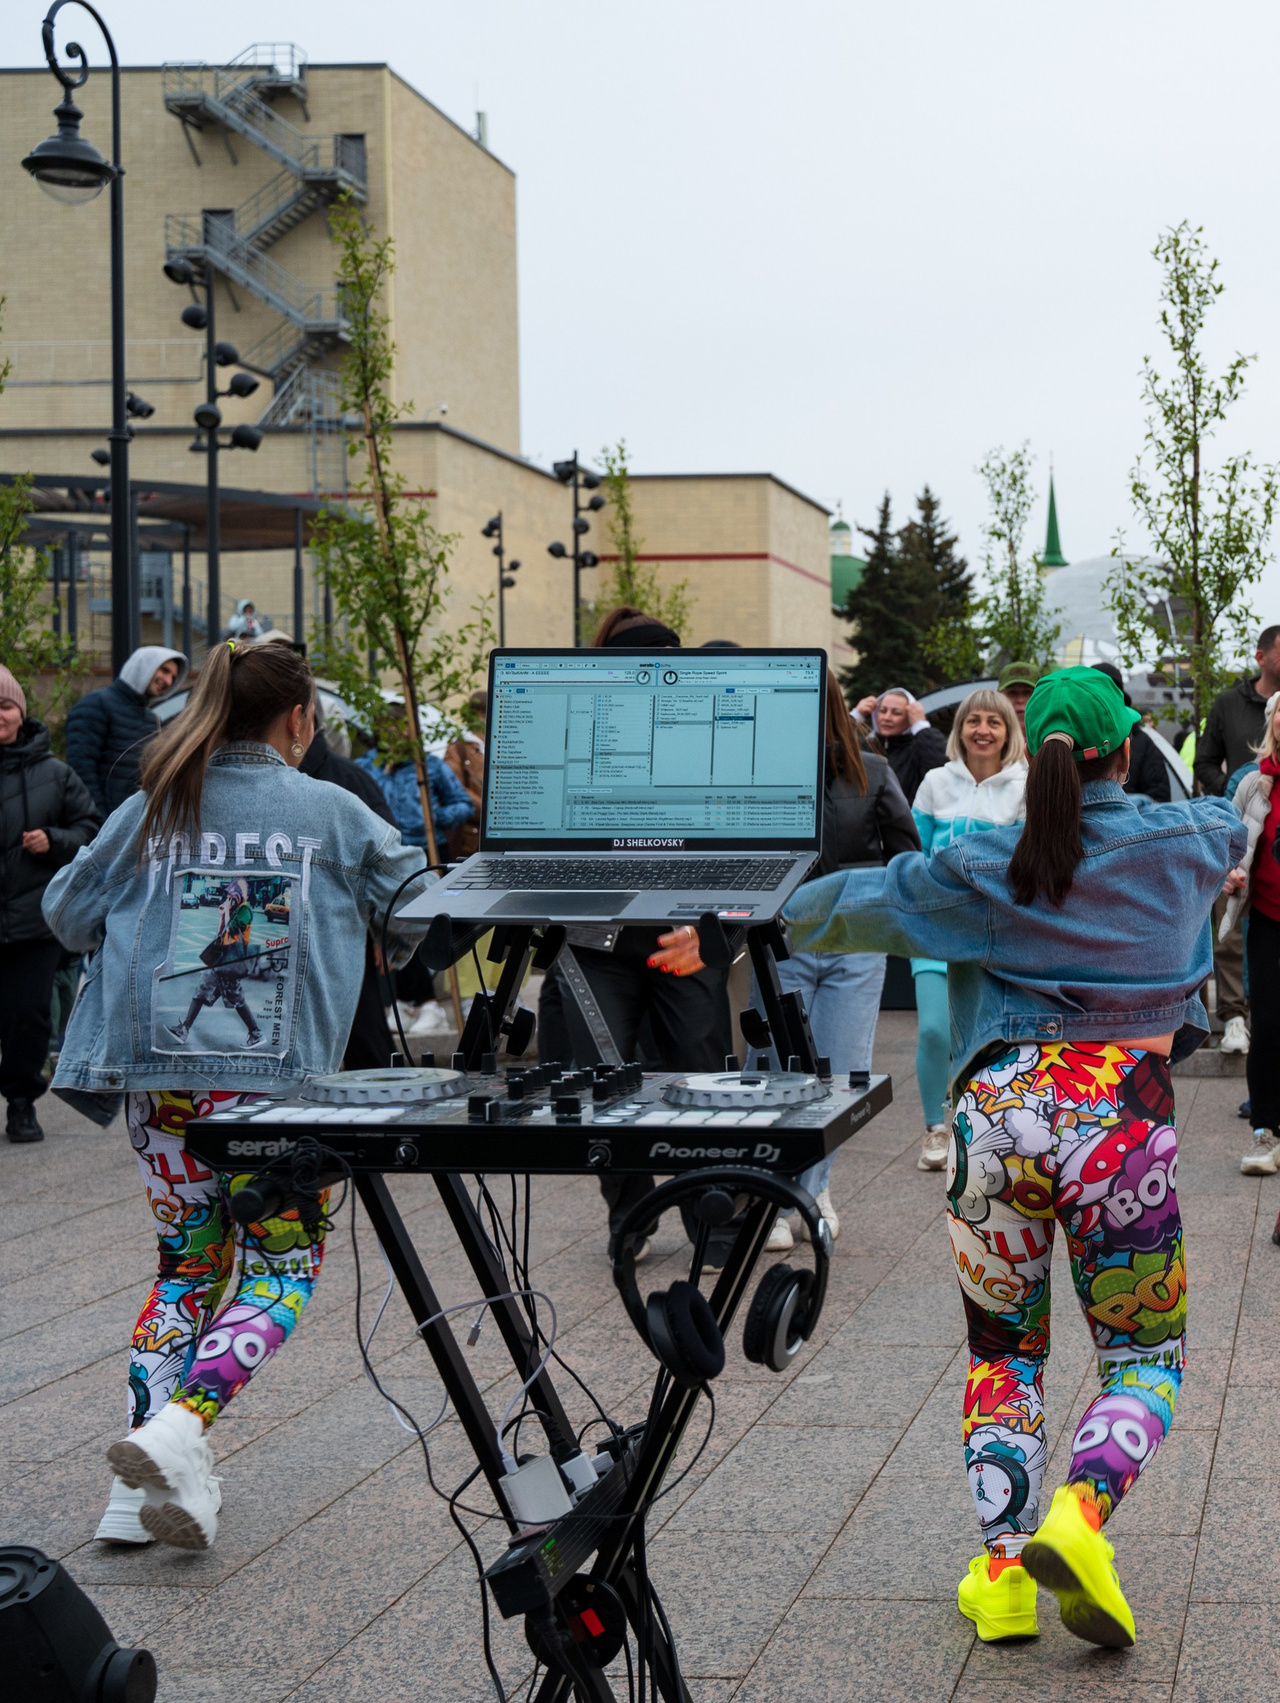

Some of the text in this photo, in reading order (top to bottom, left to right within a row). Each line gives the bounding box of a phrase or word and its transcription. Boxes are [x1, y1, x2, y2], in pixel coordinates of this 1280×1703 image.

[613, 839, 684, 847] DJ SHELKOVSKY
[274, 975, 284, 1020] FOREST
[272, 1023, 281, 1046] MEN
[228, 1137, 298, 1157] serat
[649, 1141, 748, 1159] Pioneer
